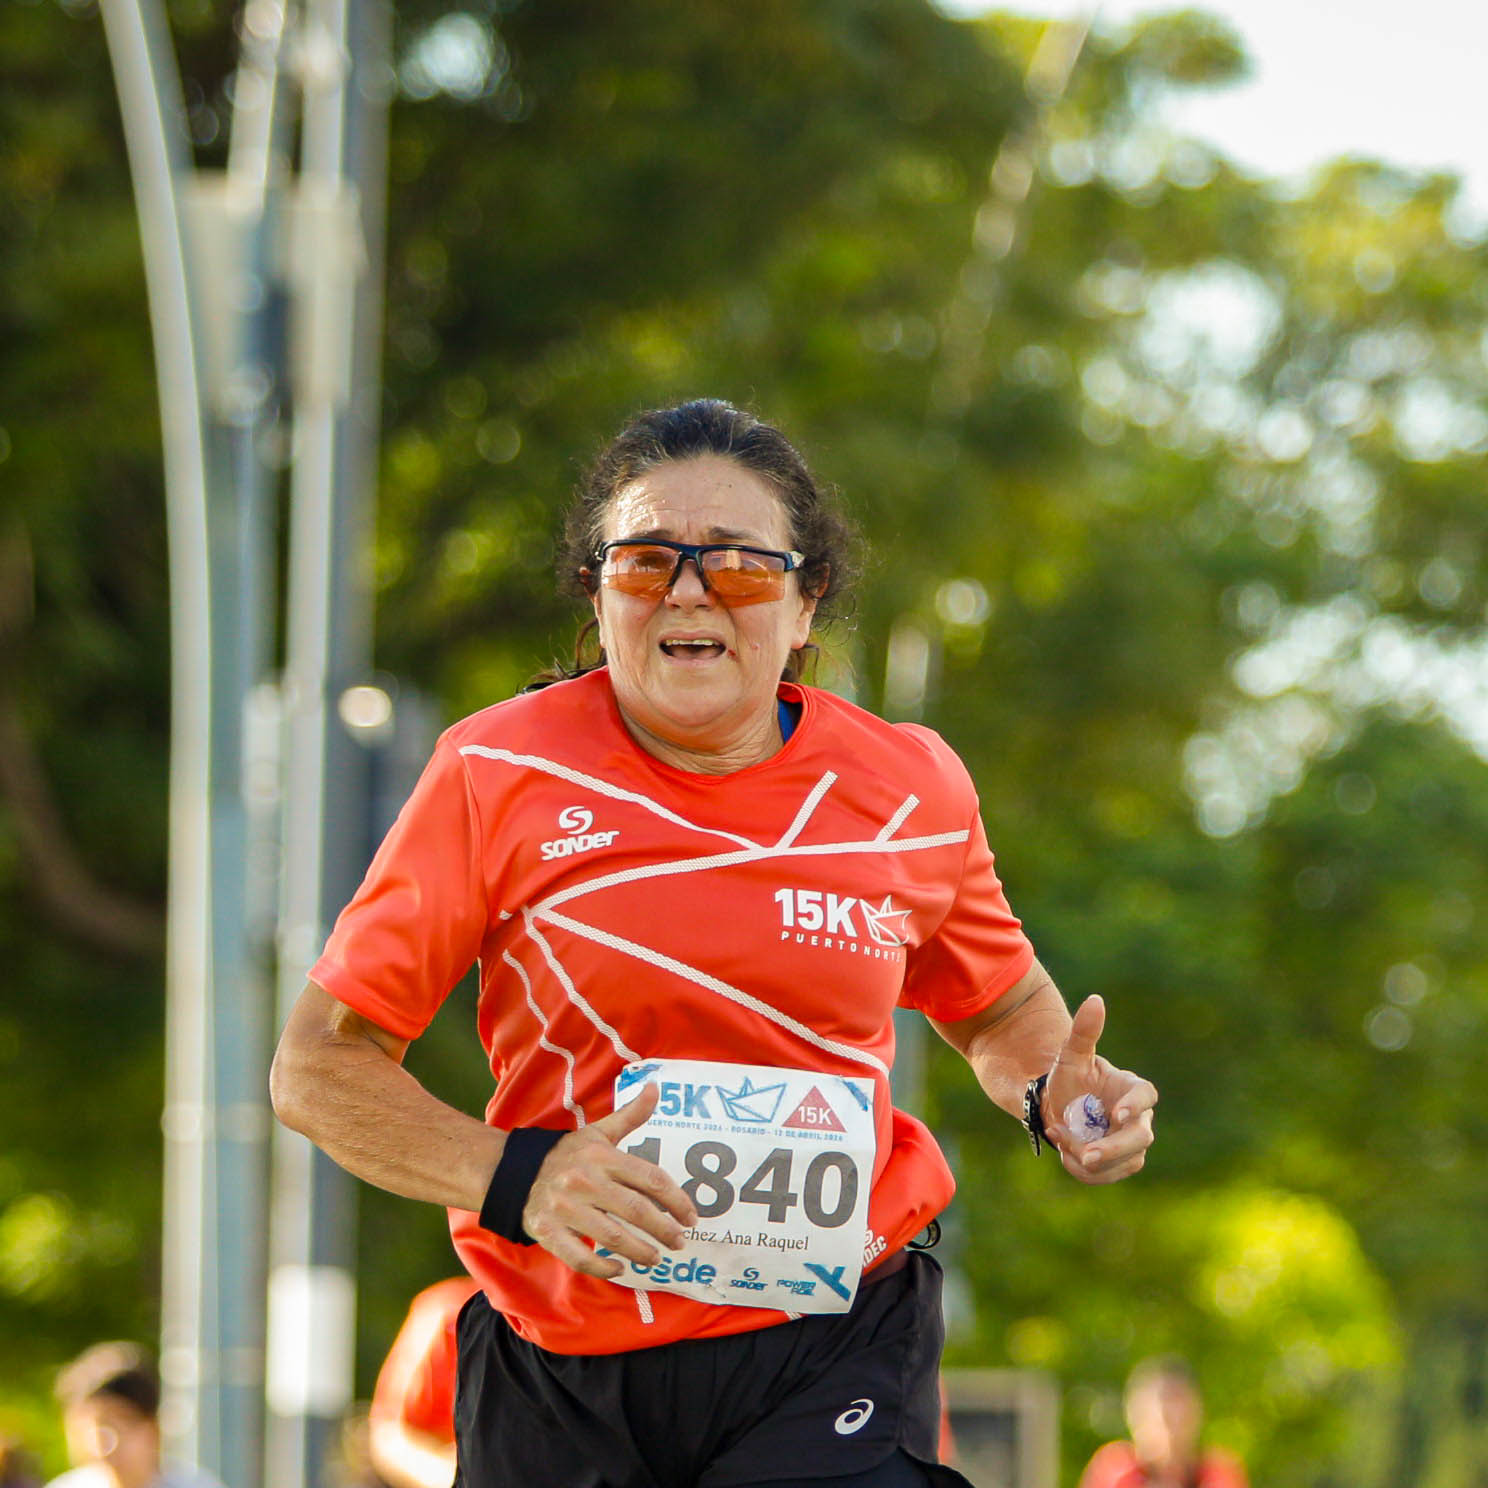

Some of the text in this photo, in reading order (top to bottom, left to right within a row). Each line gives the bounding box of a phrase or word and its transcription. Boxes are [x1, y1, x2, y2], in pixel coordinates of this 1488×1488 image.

[774, 887, 858, 938] 15K
[781, 931, 857, 952] PUERTO
[653, 1081, 712, 1119] 5K
[647, 1119, 673, 1128] UERTO
[675, 1120, 701, 1130] NORTE
[798, 1106, 832, 1126] 15K
[683, 1227, 809, 1252] chez Ana Raquel
